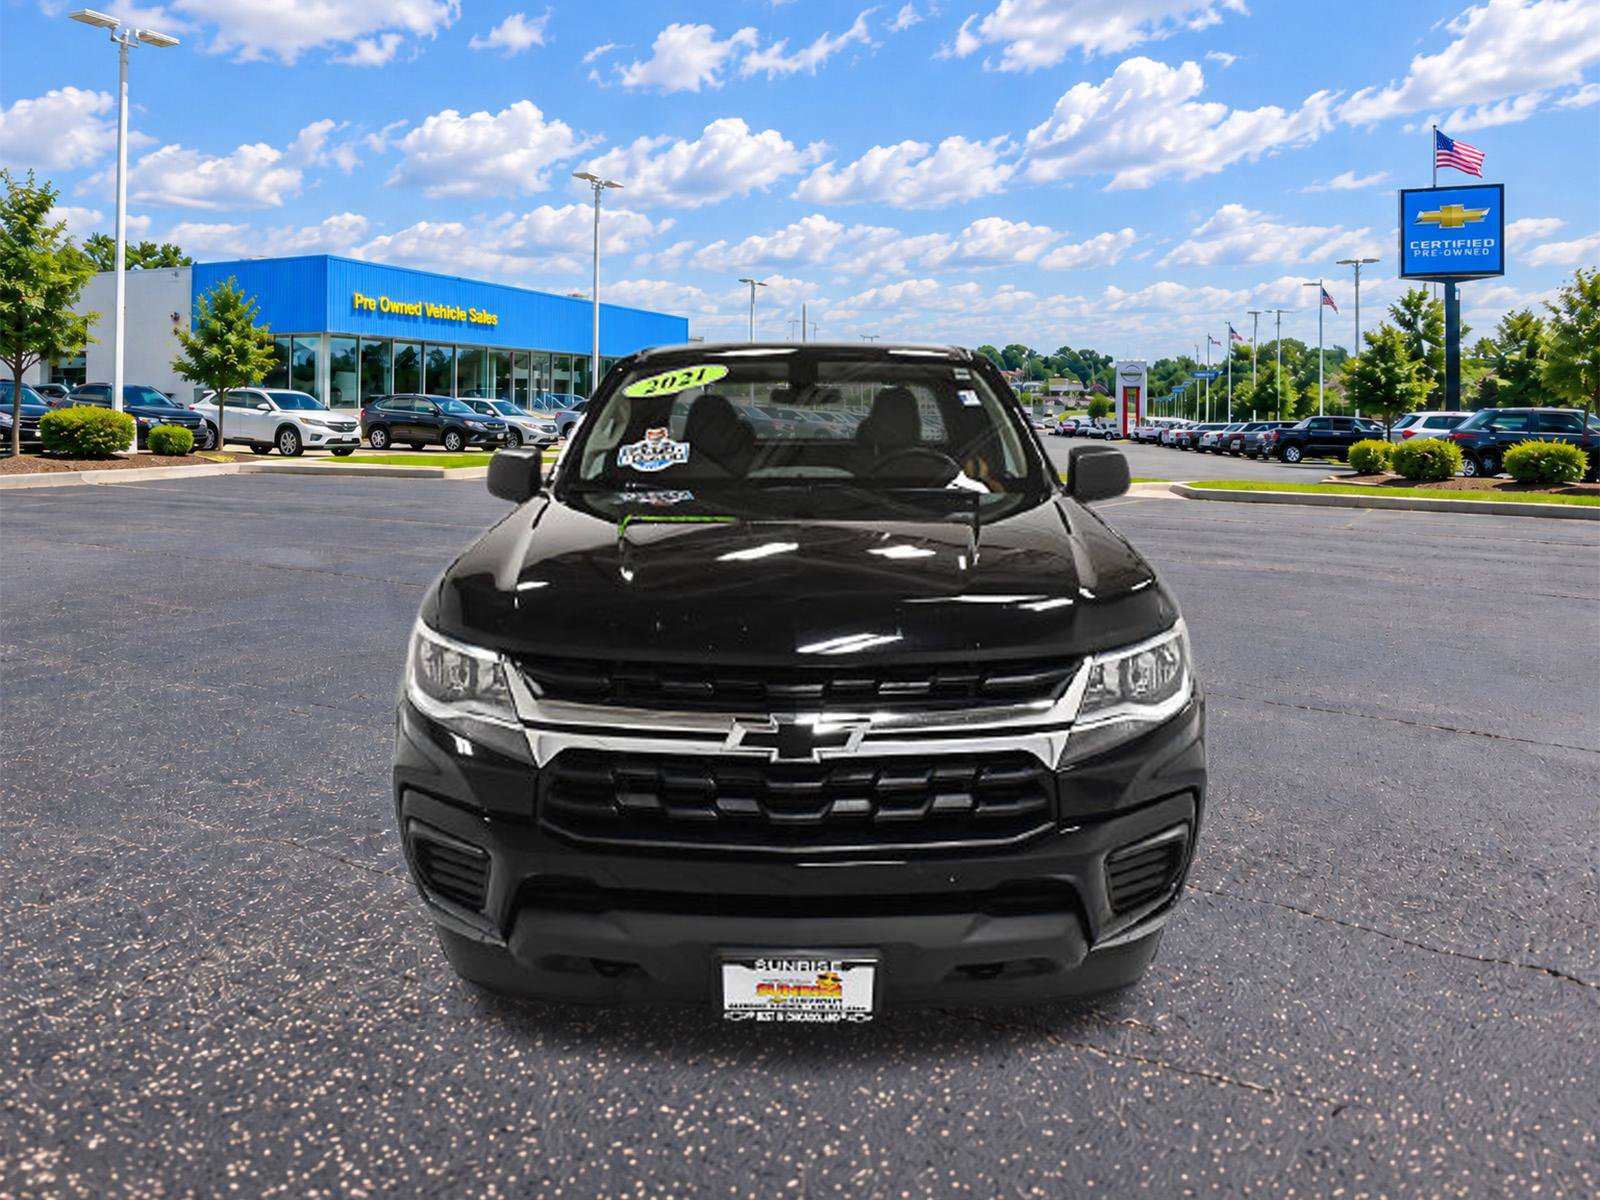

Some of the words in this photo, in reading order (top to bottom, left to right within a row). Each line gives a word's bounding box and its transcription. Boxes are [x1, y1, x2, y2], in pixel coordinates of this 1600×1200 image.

[1410, 239, 1495, 249] CERTIFIED
[1413, 248, 1490, 257] PRE-OWNED
[353, 293, 376, 311] Pre
[379, 296, 422, 316] Owned
[424, 302, 467, 321] Vehicle
[469, 308, 498, 325] Sales
[644, 367, 706, 394] 2021
[755, 958, 842, 971] SUNRISE
